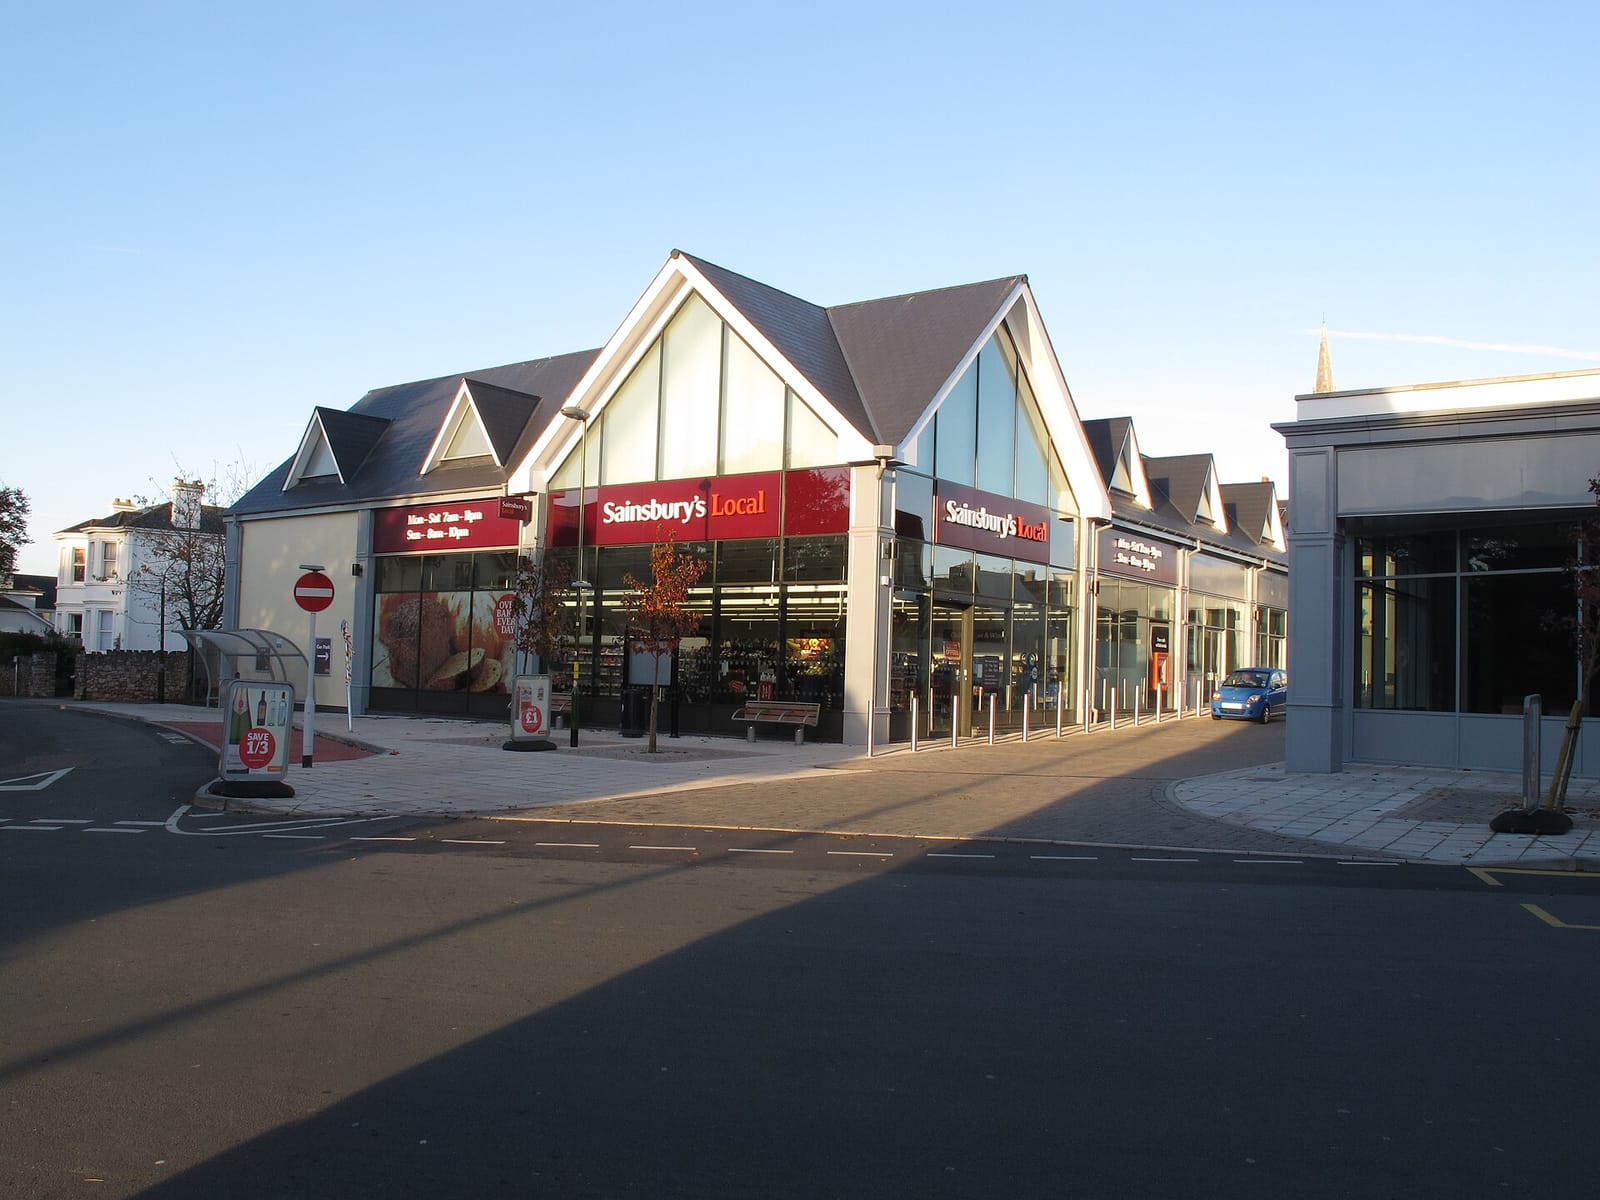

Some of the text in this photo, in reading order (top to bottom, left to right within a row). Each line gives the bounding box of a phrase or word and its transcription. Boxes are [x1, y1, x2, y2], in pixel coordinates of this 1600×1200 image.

[602, 490, 767, 524] Sainsbury's Local
[945, 500, 1048, 542] Sainsbury's Local
[497, 617, 516, 626] EVER
[501, 626, 515, 634] DAY
[526, 711, 538, 724] £1
[247, 732, 270, 741] SAVE
[247, 740, 269, 755] 1/3
